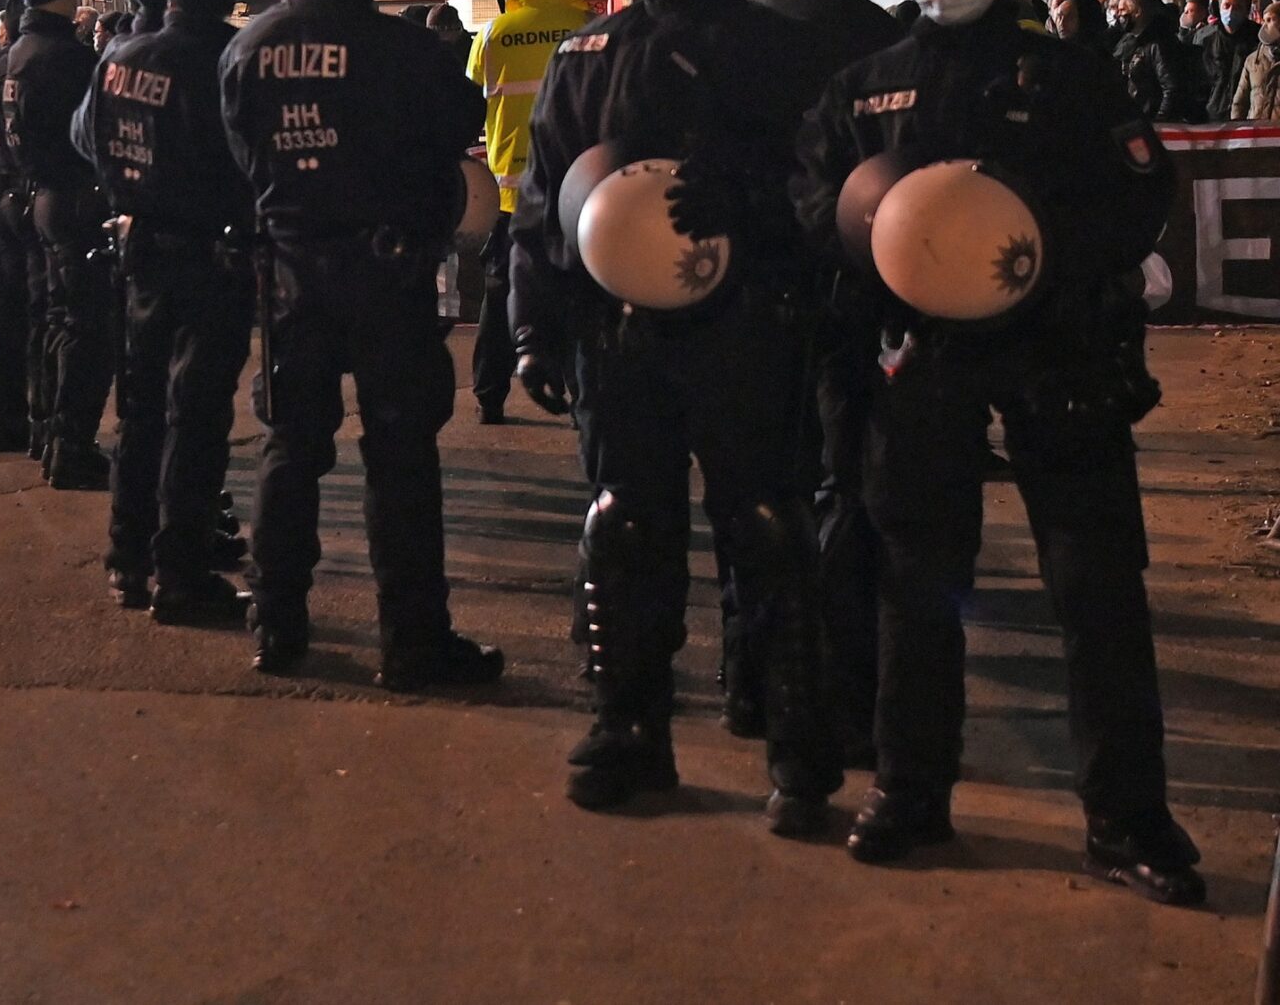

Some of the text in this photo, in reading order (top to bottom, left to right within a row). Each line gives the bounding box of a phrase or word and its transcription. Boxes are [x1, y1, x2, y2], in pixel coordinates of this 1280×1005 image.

[259, 44, 348, 79] POLIZEI
[104, 62, 172, 106] POLIZEI
[282, 103, 321, 128] HH
[119, 118, 144, 144] HH
[273, 128, 338, 150] 133330
